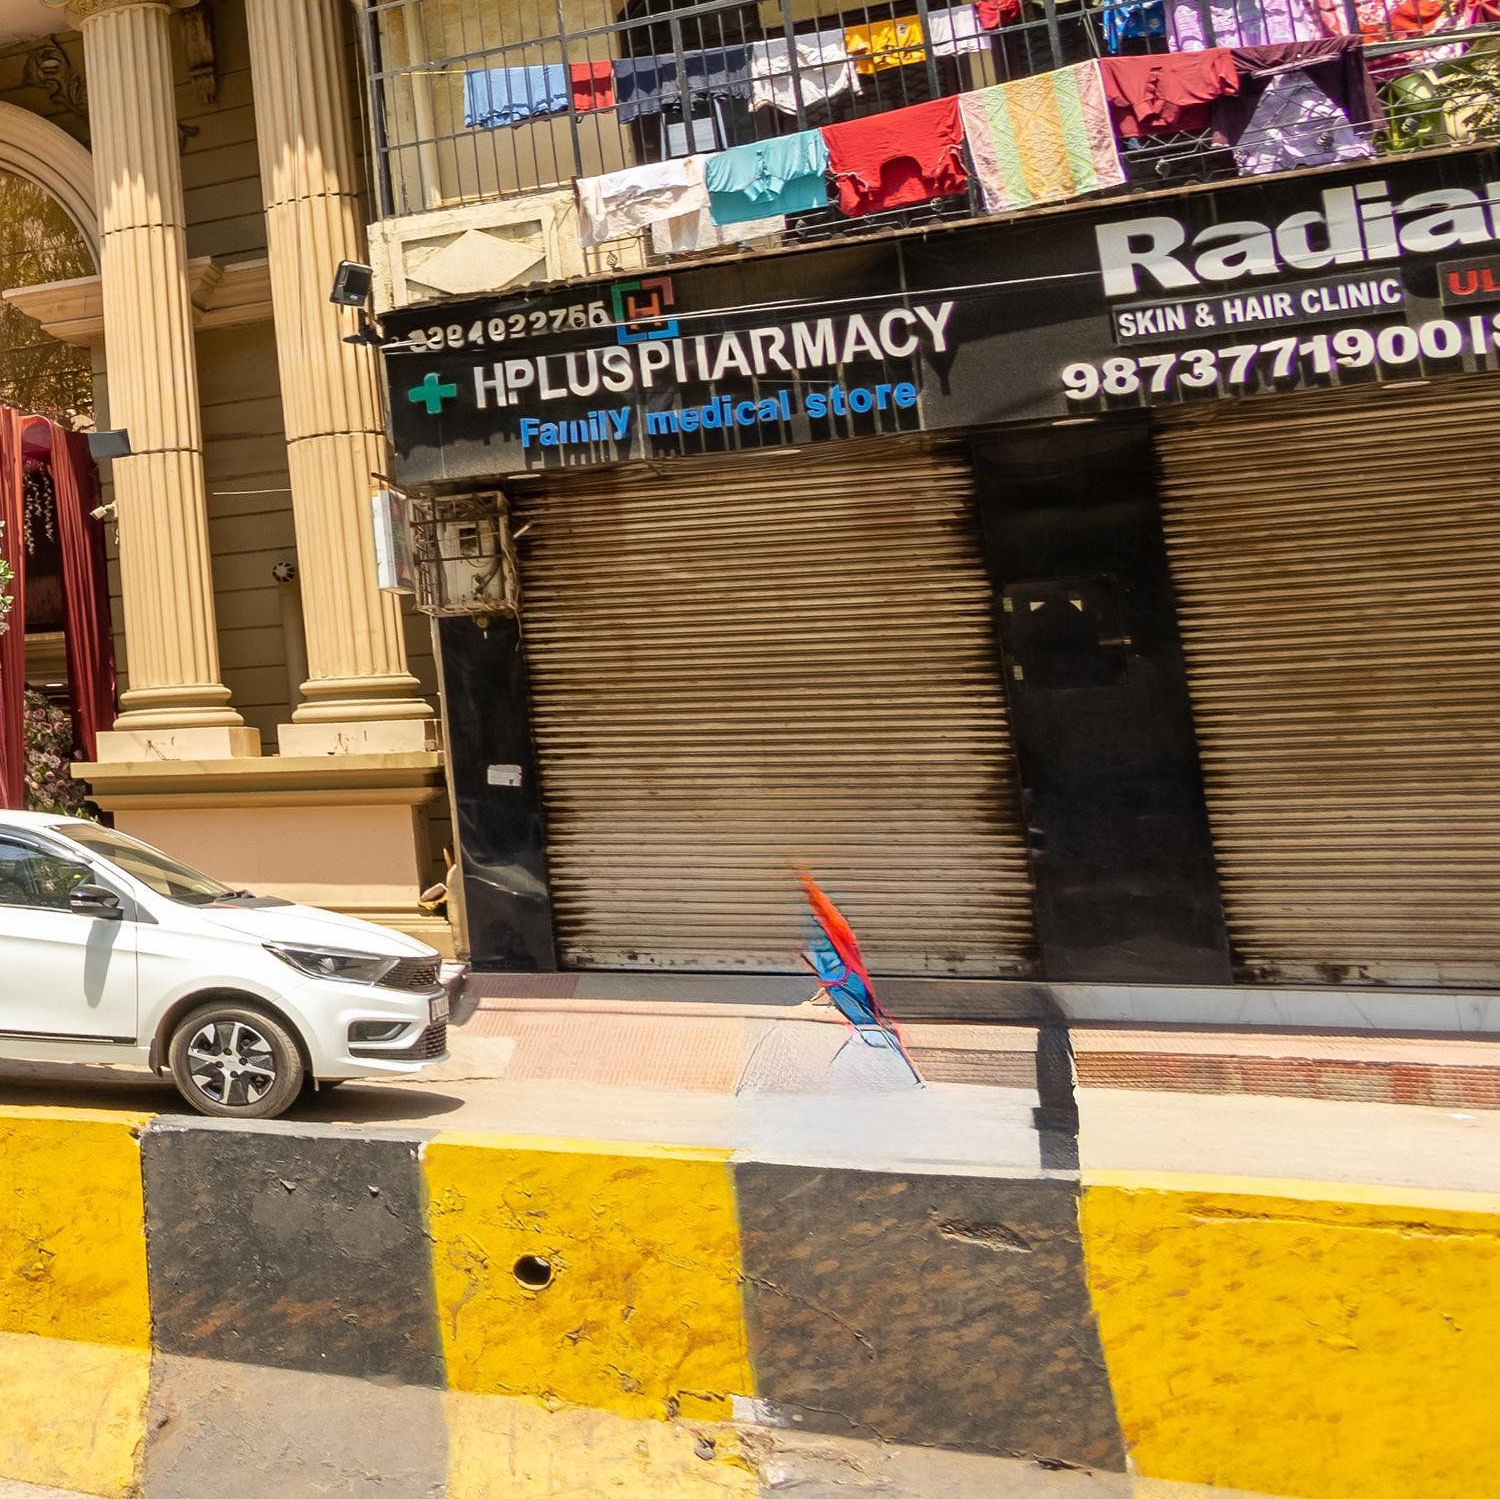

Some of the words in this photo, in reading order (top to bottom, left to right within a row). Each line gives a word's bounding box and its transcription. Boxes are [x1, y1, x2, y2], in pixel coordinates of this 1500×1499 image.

[1117, 303, 1187, 337] SKIN
[1194, 301, 1216, 328] &
[1224, 292, 1294, 325] HAIR
[1301, 278, 1402, 314] CLINIC
[647, 389, 792, 436] medical
[806, 381, 918, 419] store
